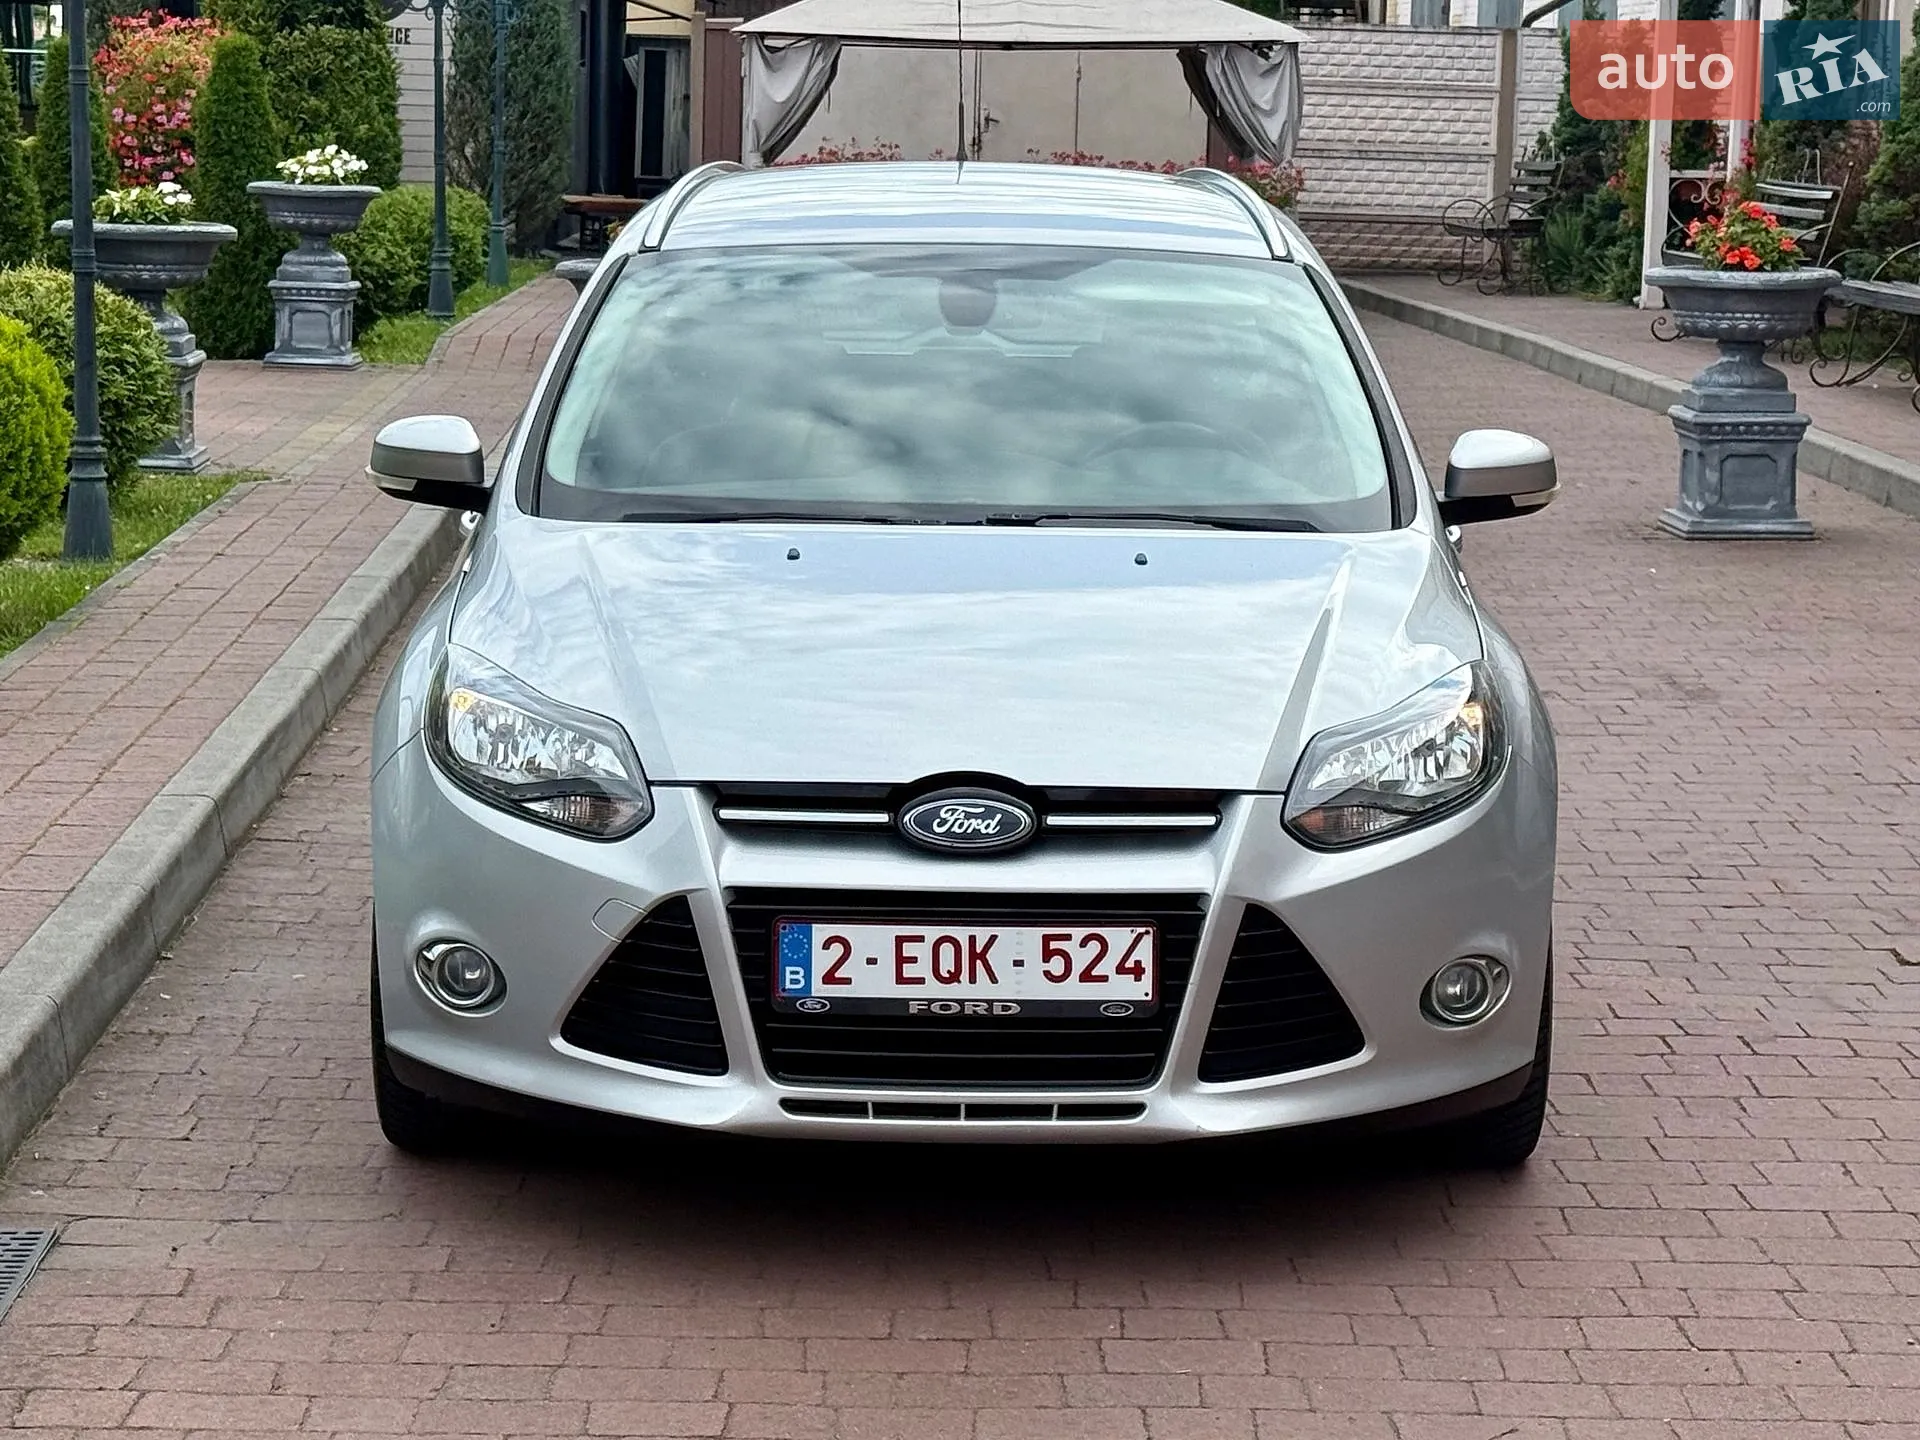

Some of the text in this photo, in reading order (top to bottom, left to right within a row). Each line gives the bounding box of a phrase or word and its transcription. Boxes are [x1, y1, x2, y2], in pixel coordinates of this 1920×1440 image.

[932, 805, 1002, 835] Ford
[785, 966, 805, 990] B
[908, 1000, 1022, 1016] FORD
